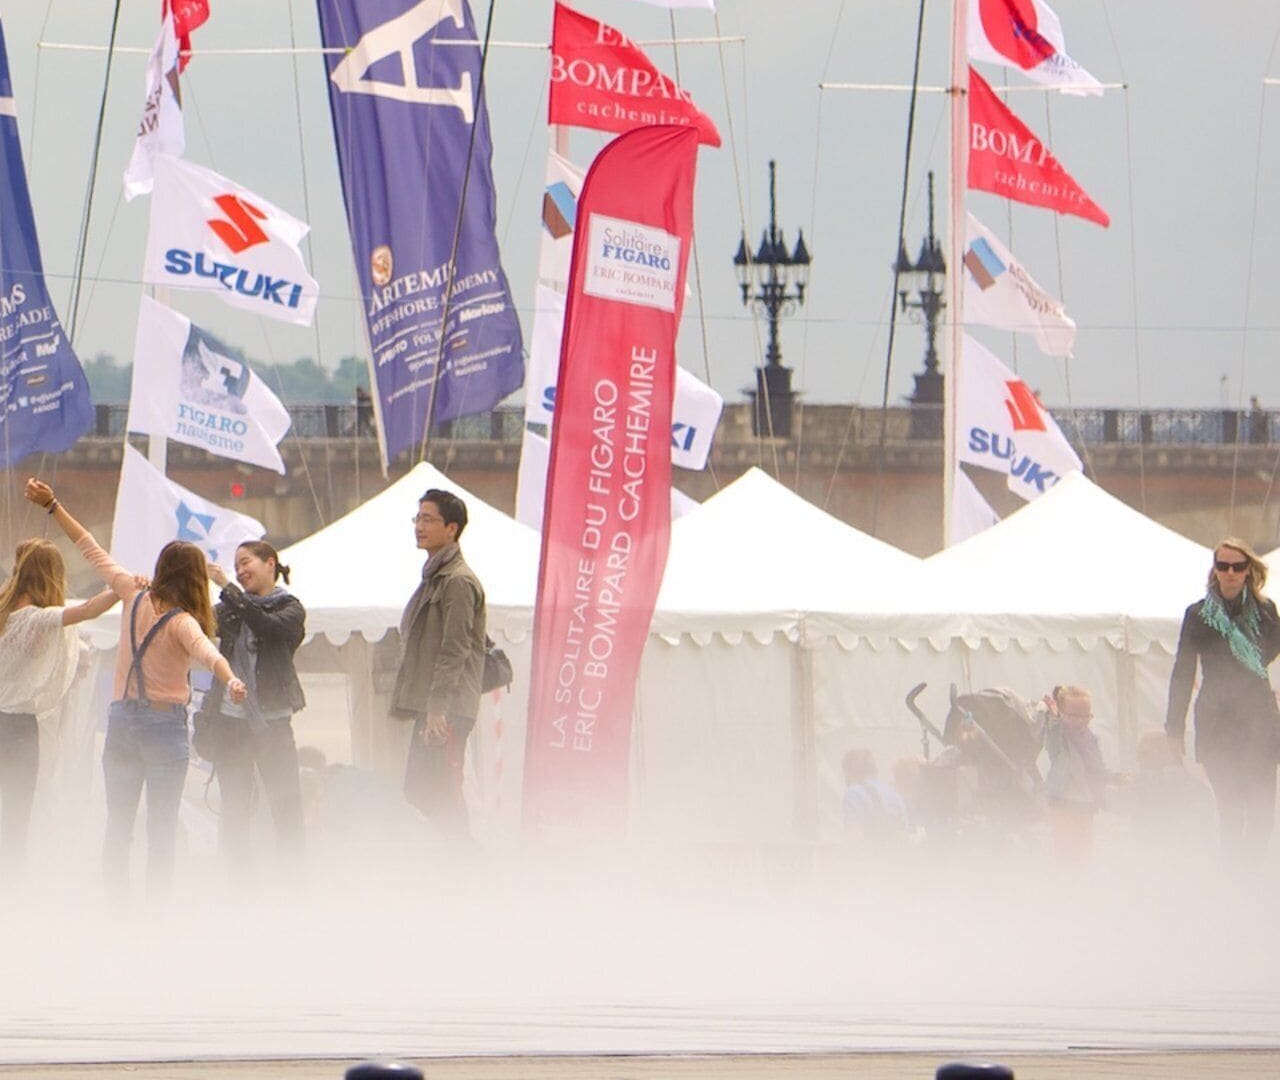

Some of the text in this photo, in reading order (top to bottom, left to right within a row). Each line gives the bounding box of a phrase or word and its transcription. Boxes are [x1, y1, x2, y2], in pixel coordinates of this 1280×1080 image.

[576, 99, 691, 126] cachemire
[602, 244, 670, 271] FIGARO
[603, 227, 662, 255] Solitaire
[164, 248, 303, 309] SUZUKI
[178, 403, 248, 437] FIGARO
[548, 377, 619, 749] LA SOLITAIRE DU FIGARO
[574, 345, 657, 753] ERIC BOMPARD CACHEMIRE
